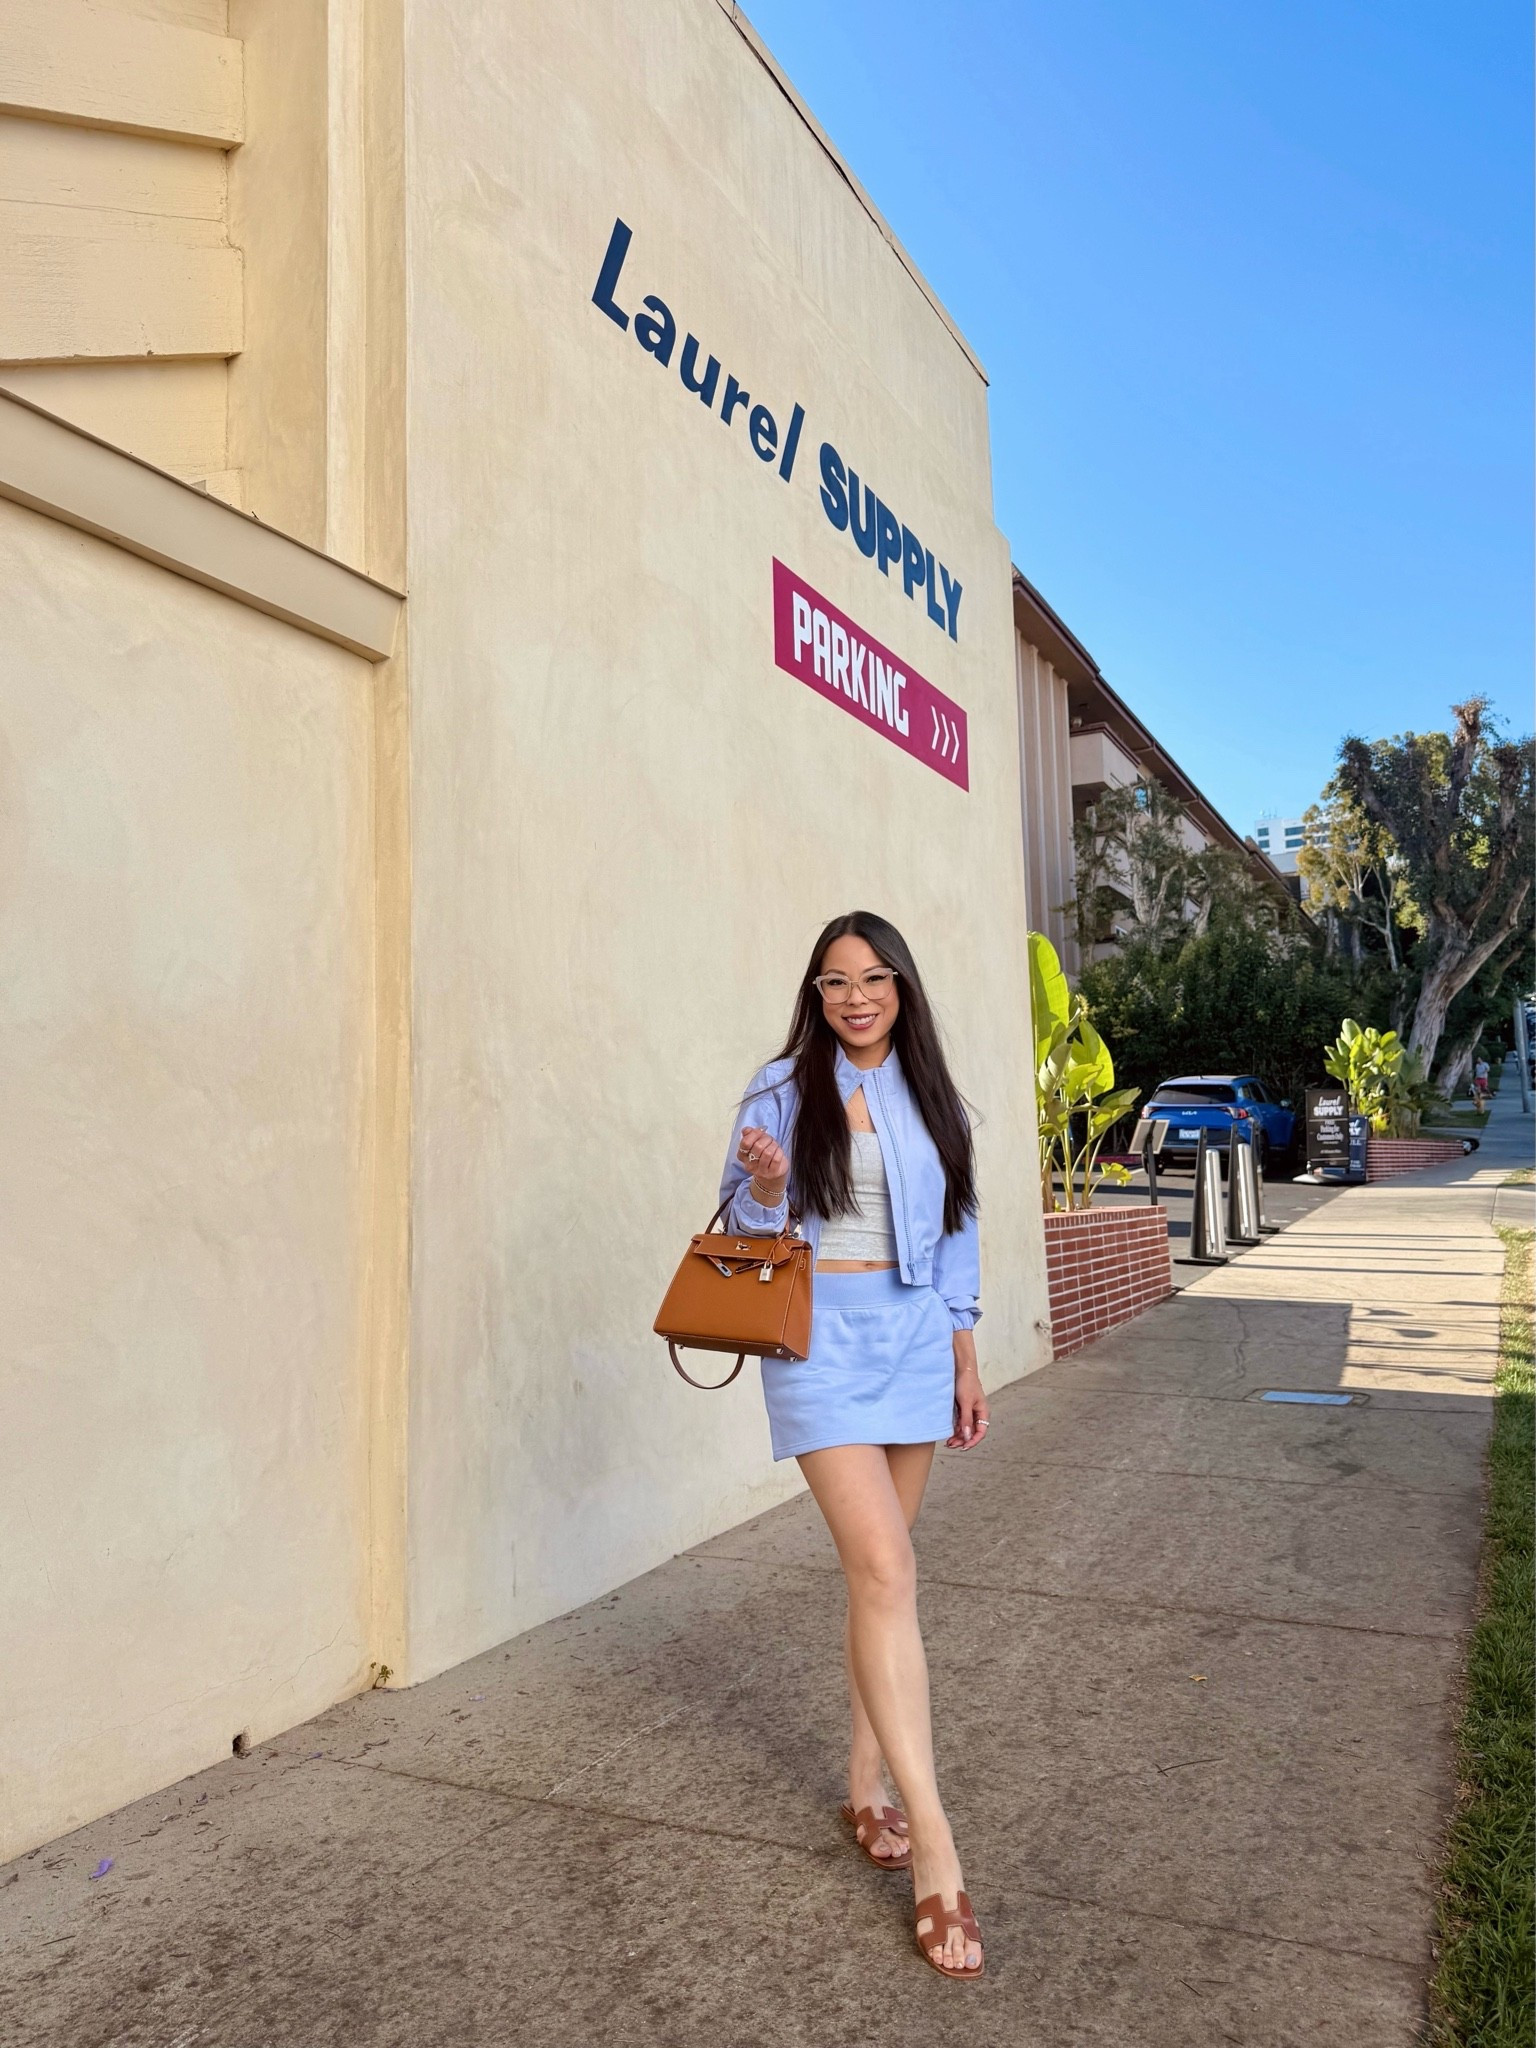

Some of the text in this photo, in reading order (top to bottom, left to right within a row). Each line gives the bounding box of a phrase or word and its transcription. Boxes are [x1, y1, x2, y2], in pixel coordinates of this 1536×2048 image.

[591, 217, 963, 643] Laurel SUPPLY
[792, 590, 910, 738] PARKING
[1314, 1106, 1344, 1116] SUPPLY
[1318, 1096, 1341, 1106] Laurel
